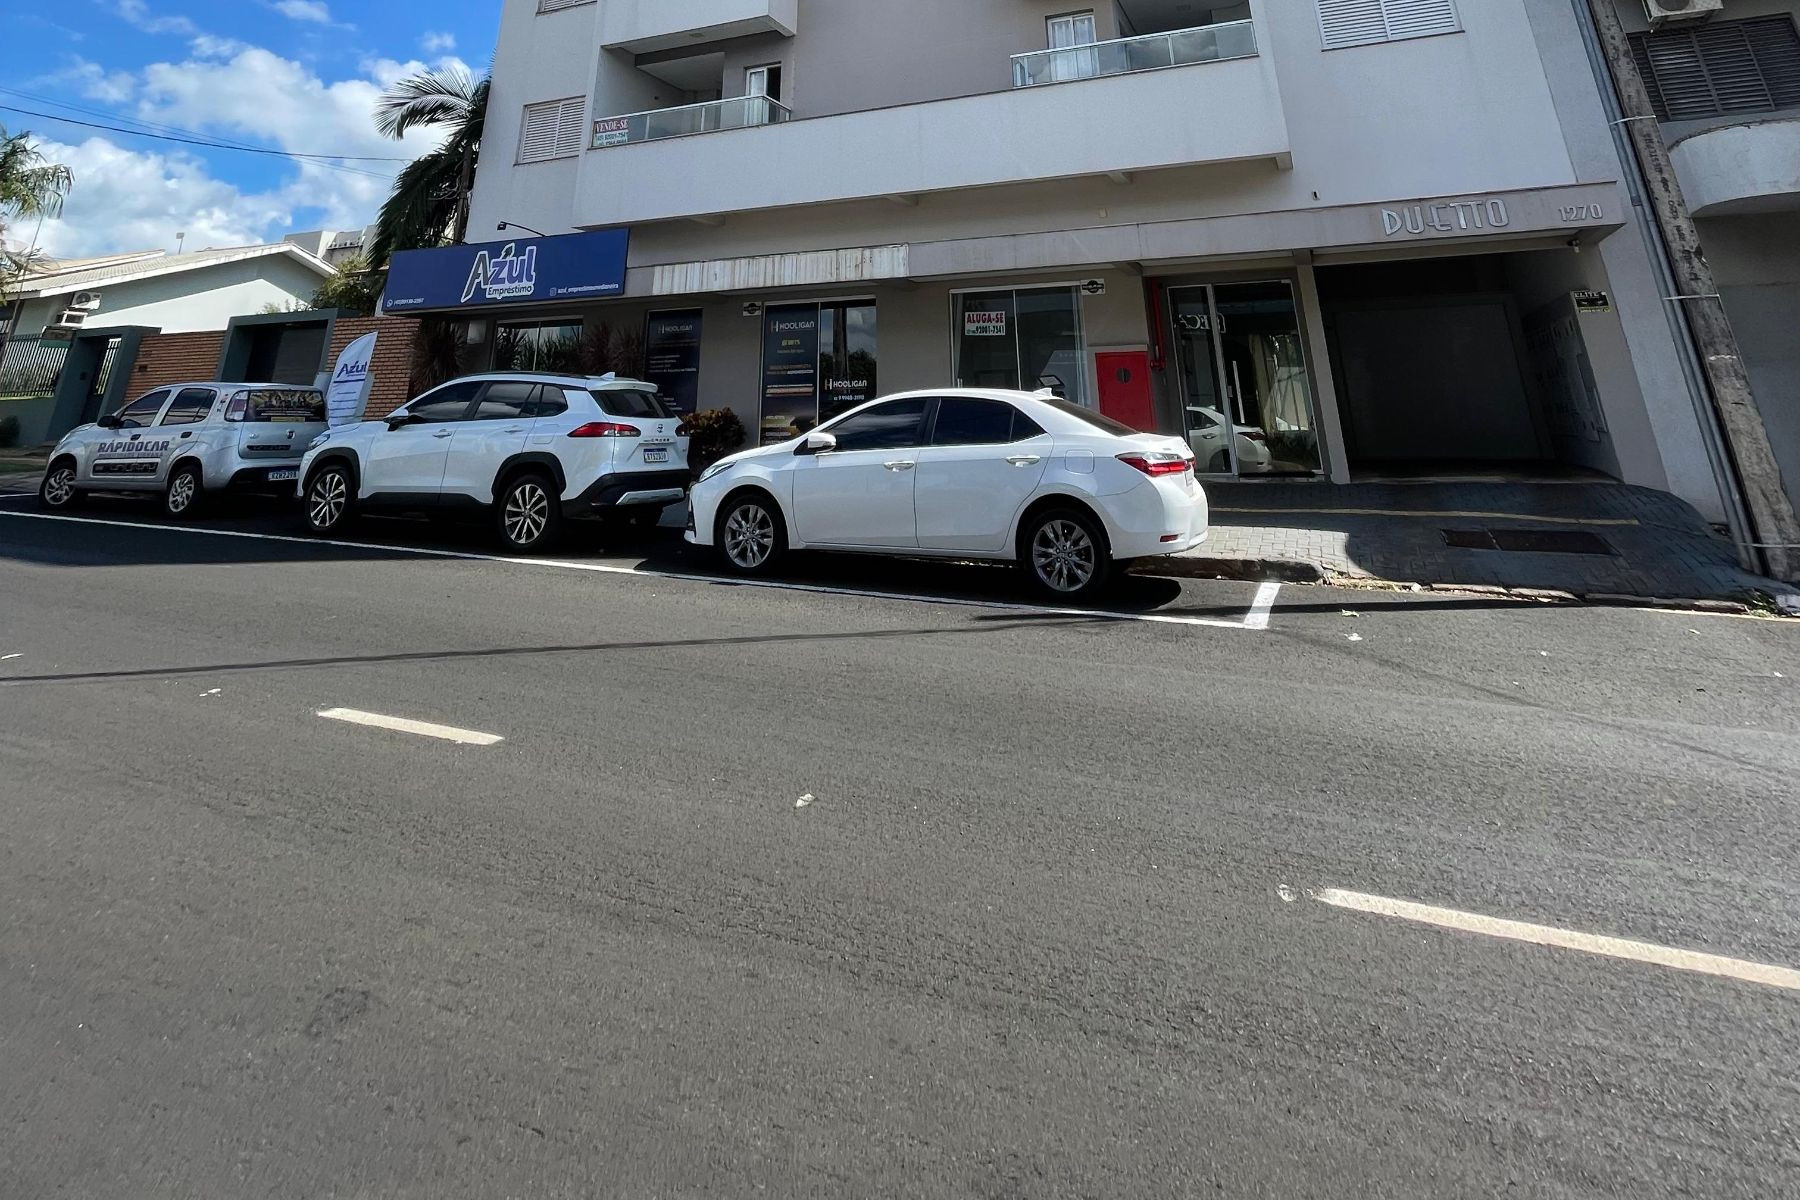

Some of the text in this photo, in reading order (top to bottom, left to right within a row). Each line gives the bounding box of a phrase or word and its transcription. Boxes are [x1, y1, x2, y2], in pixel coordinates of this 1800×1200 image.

[596, 119, 629, 133] VENDE-SE
[1381, 199, 1603, 236] DUETTO 1270
[461, 242, 537, 303] Azul
[966, 312, 1004, 324] ALUGA-SE
[336, 360, 368, 379] Azul
